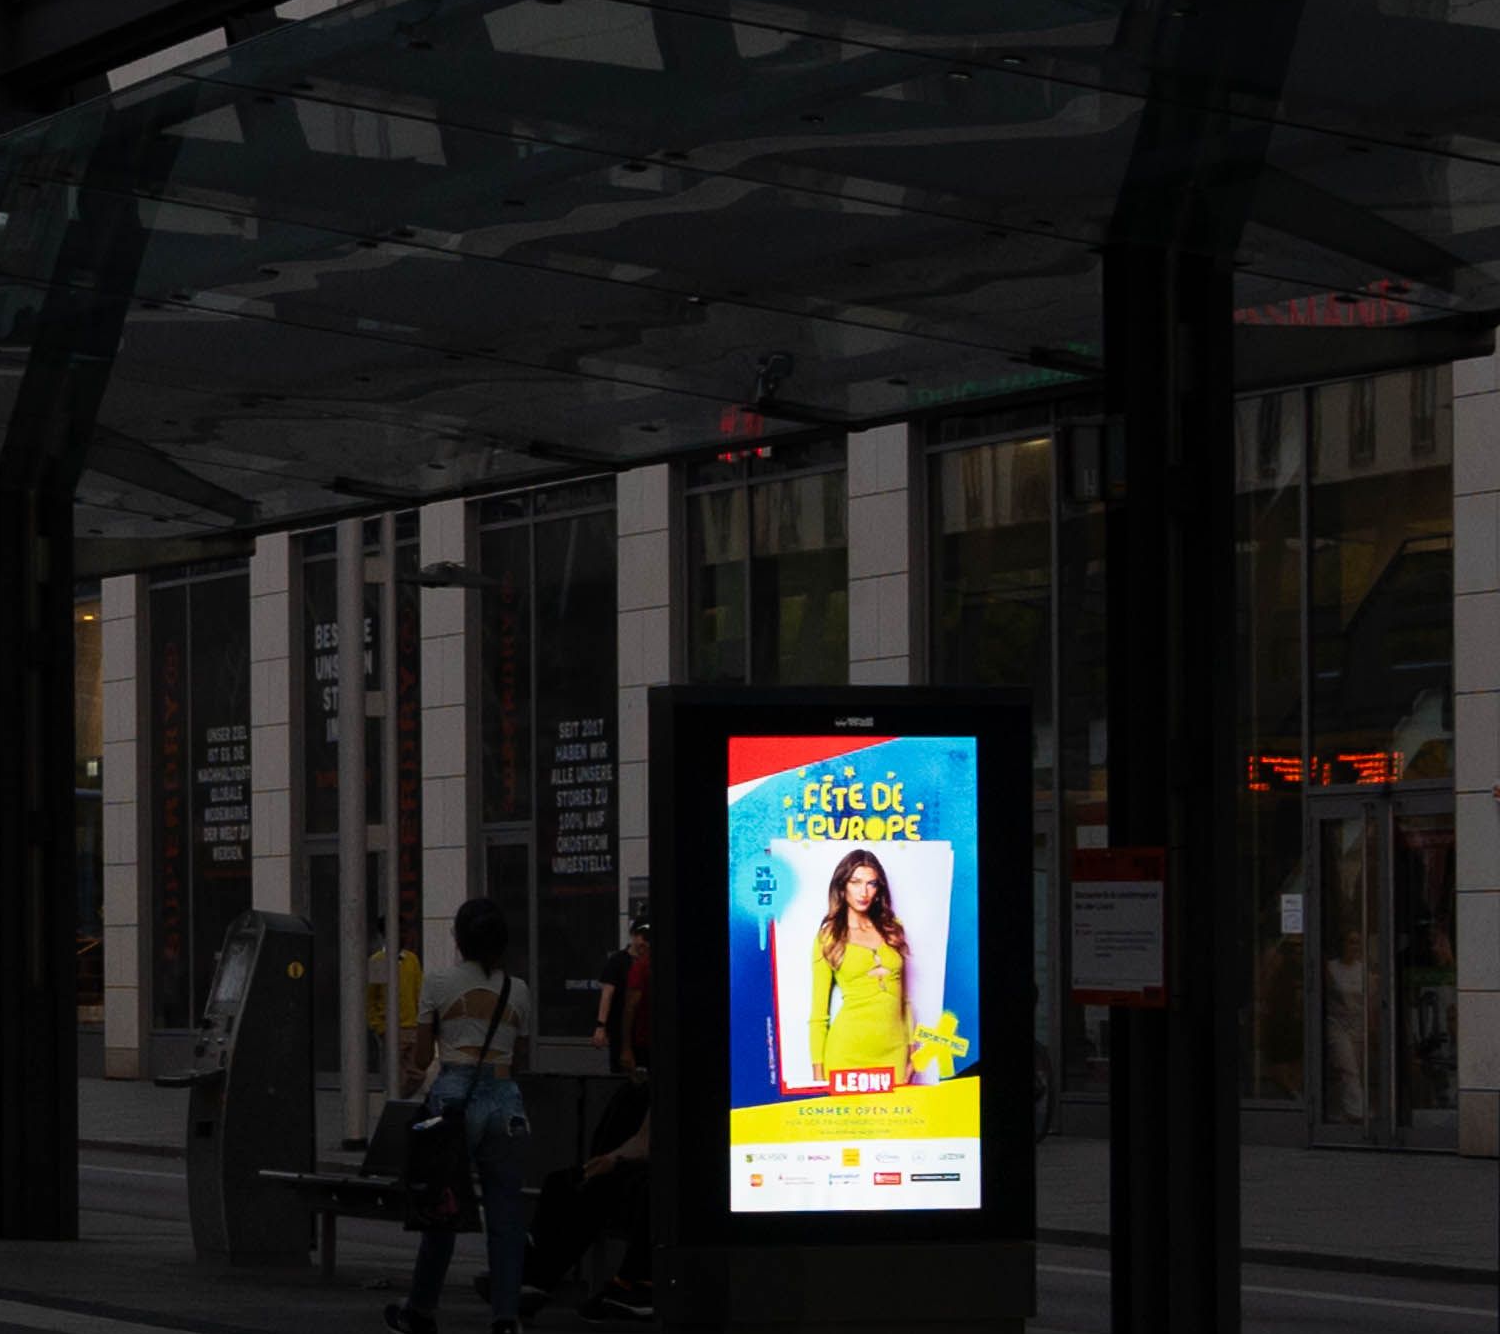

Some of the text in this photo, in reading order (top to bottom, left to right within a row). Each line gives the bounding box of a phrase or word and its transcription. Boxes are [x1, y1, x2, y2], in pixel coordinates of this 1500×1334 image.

[558, 720, 579, 739] SEIT
[555, 741, 608, 763] HABEN WIR
[551, 764, 613, 785] ALLE UNSERE
[556, 786, 608, 808] STORES ZU
[803, 774, 905, 812] FÊTE DE
[586, 810, 604, 828] AUF
[835, 1072, 891, 1092] LEONY
